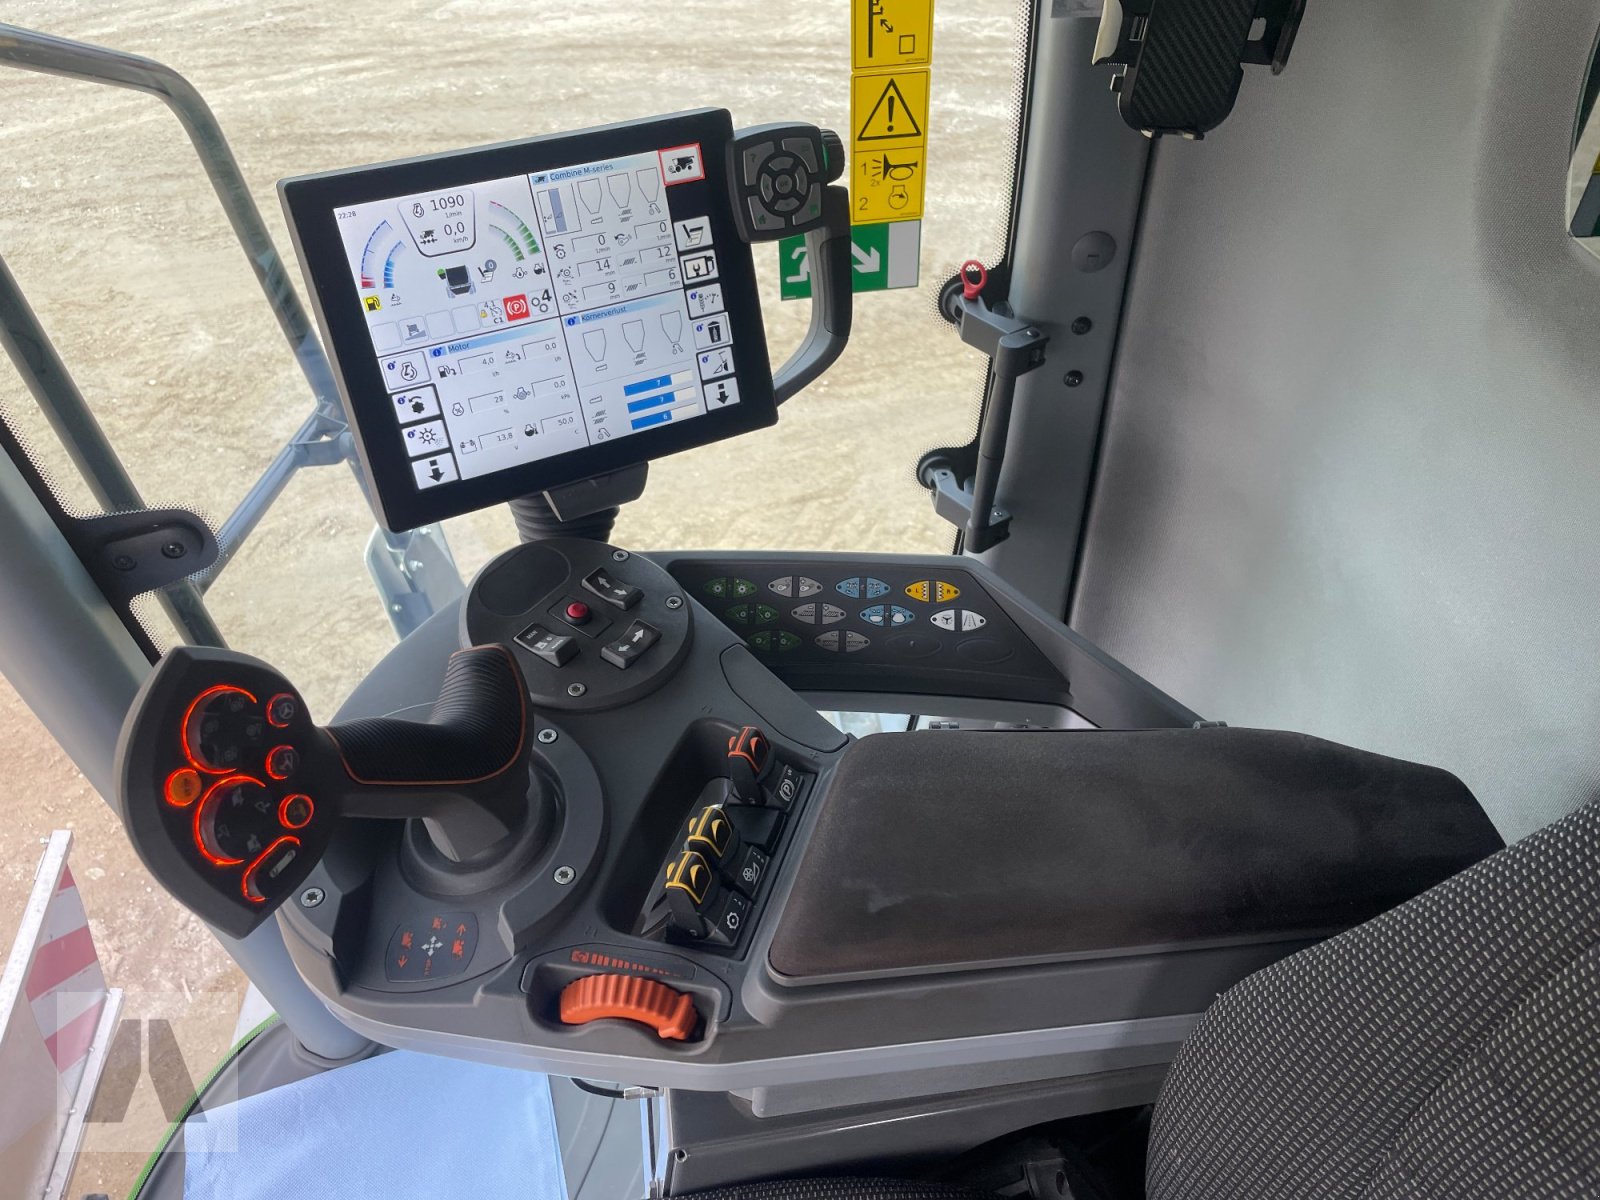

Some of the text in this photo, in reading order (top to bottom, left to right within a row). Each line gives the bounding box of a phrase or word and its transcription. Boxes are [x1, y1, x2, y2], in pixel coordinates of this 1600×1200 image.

[550, 163, 614, 182] Combine M-series
[430, 194, 465, 212] 1090
[859, 197, 868, 211] 2
[338, 211, 357, 220] 22:28
[443, 221, 465, 236] 0,0
[659, 221, 667, 233] 0
[598, 234, 606, 246] 0
[657, 246, 672, 259] 12
[595, 258, 610, 272] 14
[668, 269, 676, 280] 6
[607, 282, 616, 294] 9
[541, 288, 552, 302] 4
[447, 342, 470, 353] Motor
